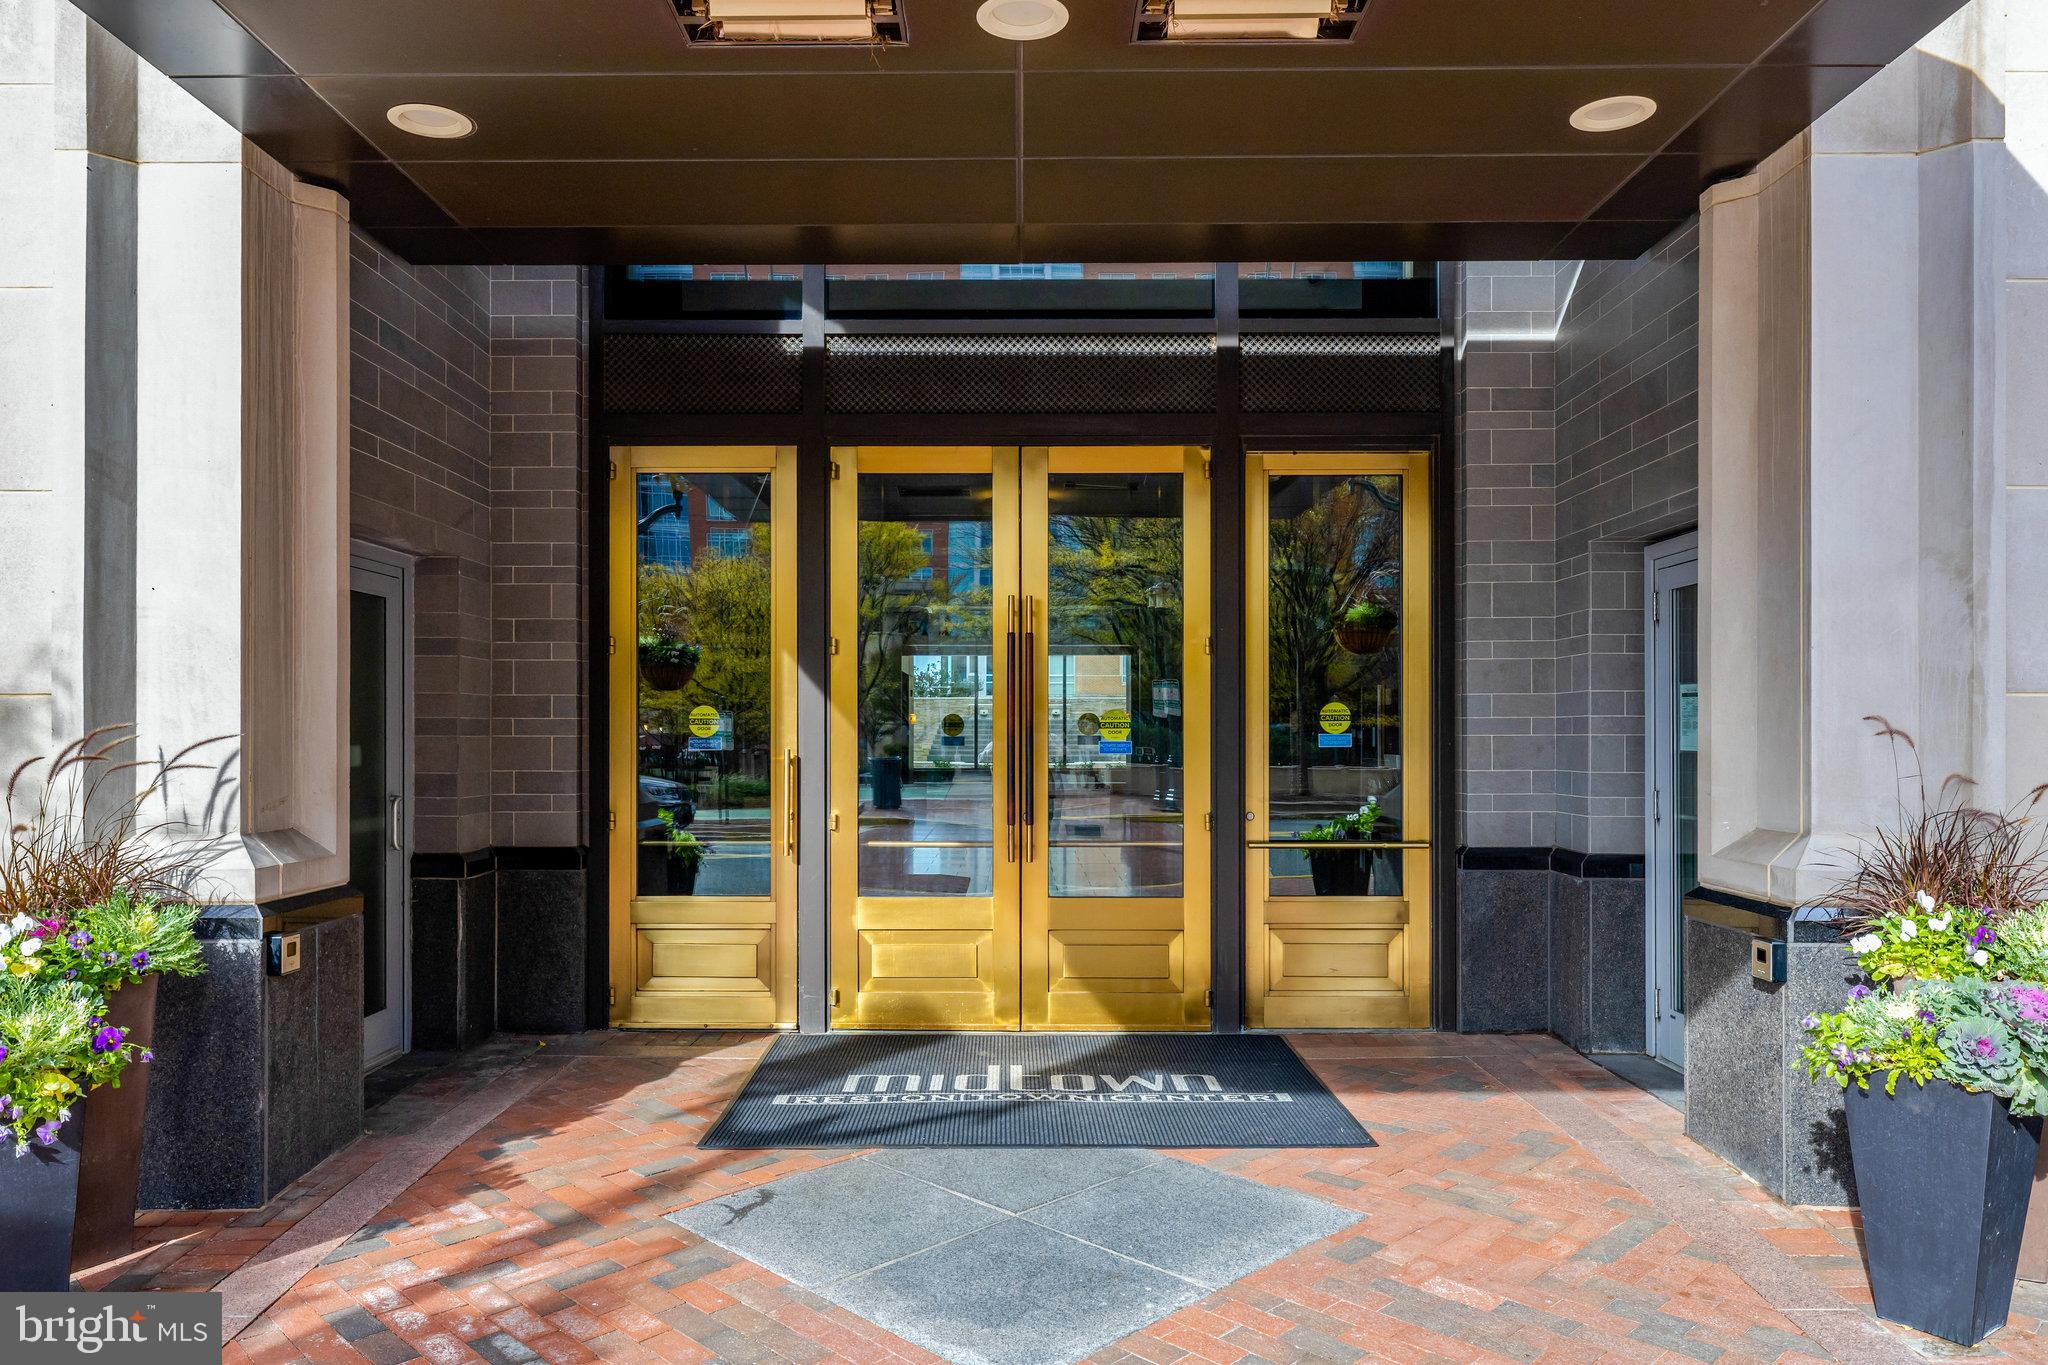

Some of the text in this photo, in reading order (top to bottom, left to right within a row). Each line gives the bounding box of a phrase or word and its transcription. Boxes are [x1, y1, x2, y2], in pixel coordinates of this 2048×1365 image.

[842, 1065, 1222, 1092] midtown
[794, 1093, 1276, 1103] RESTON TOWN CENTER
